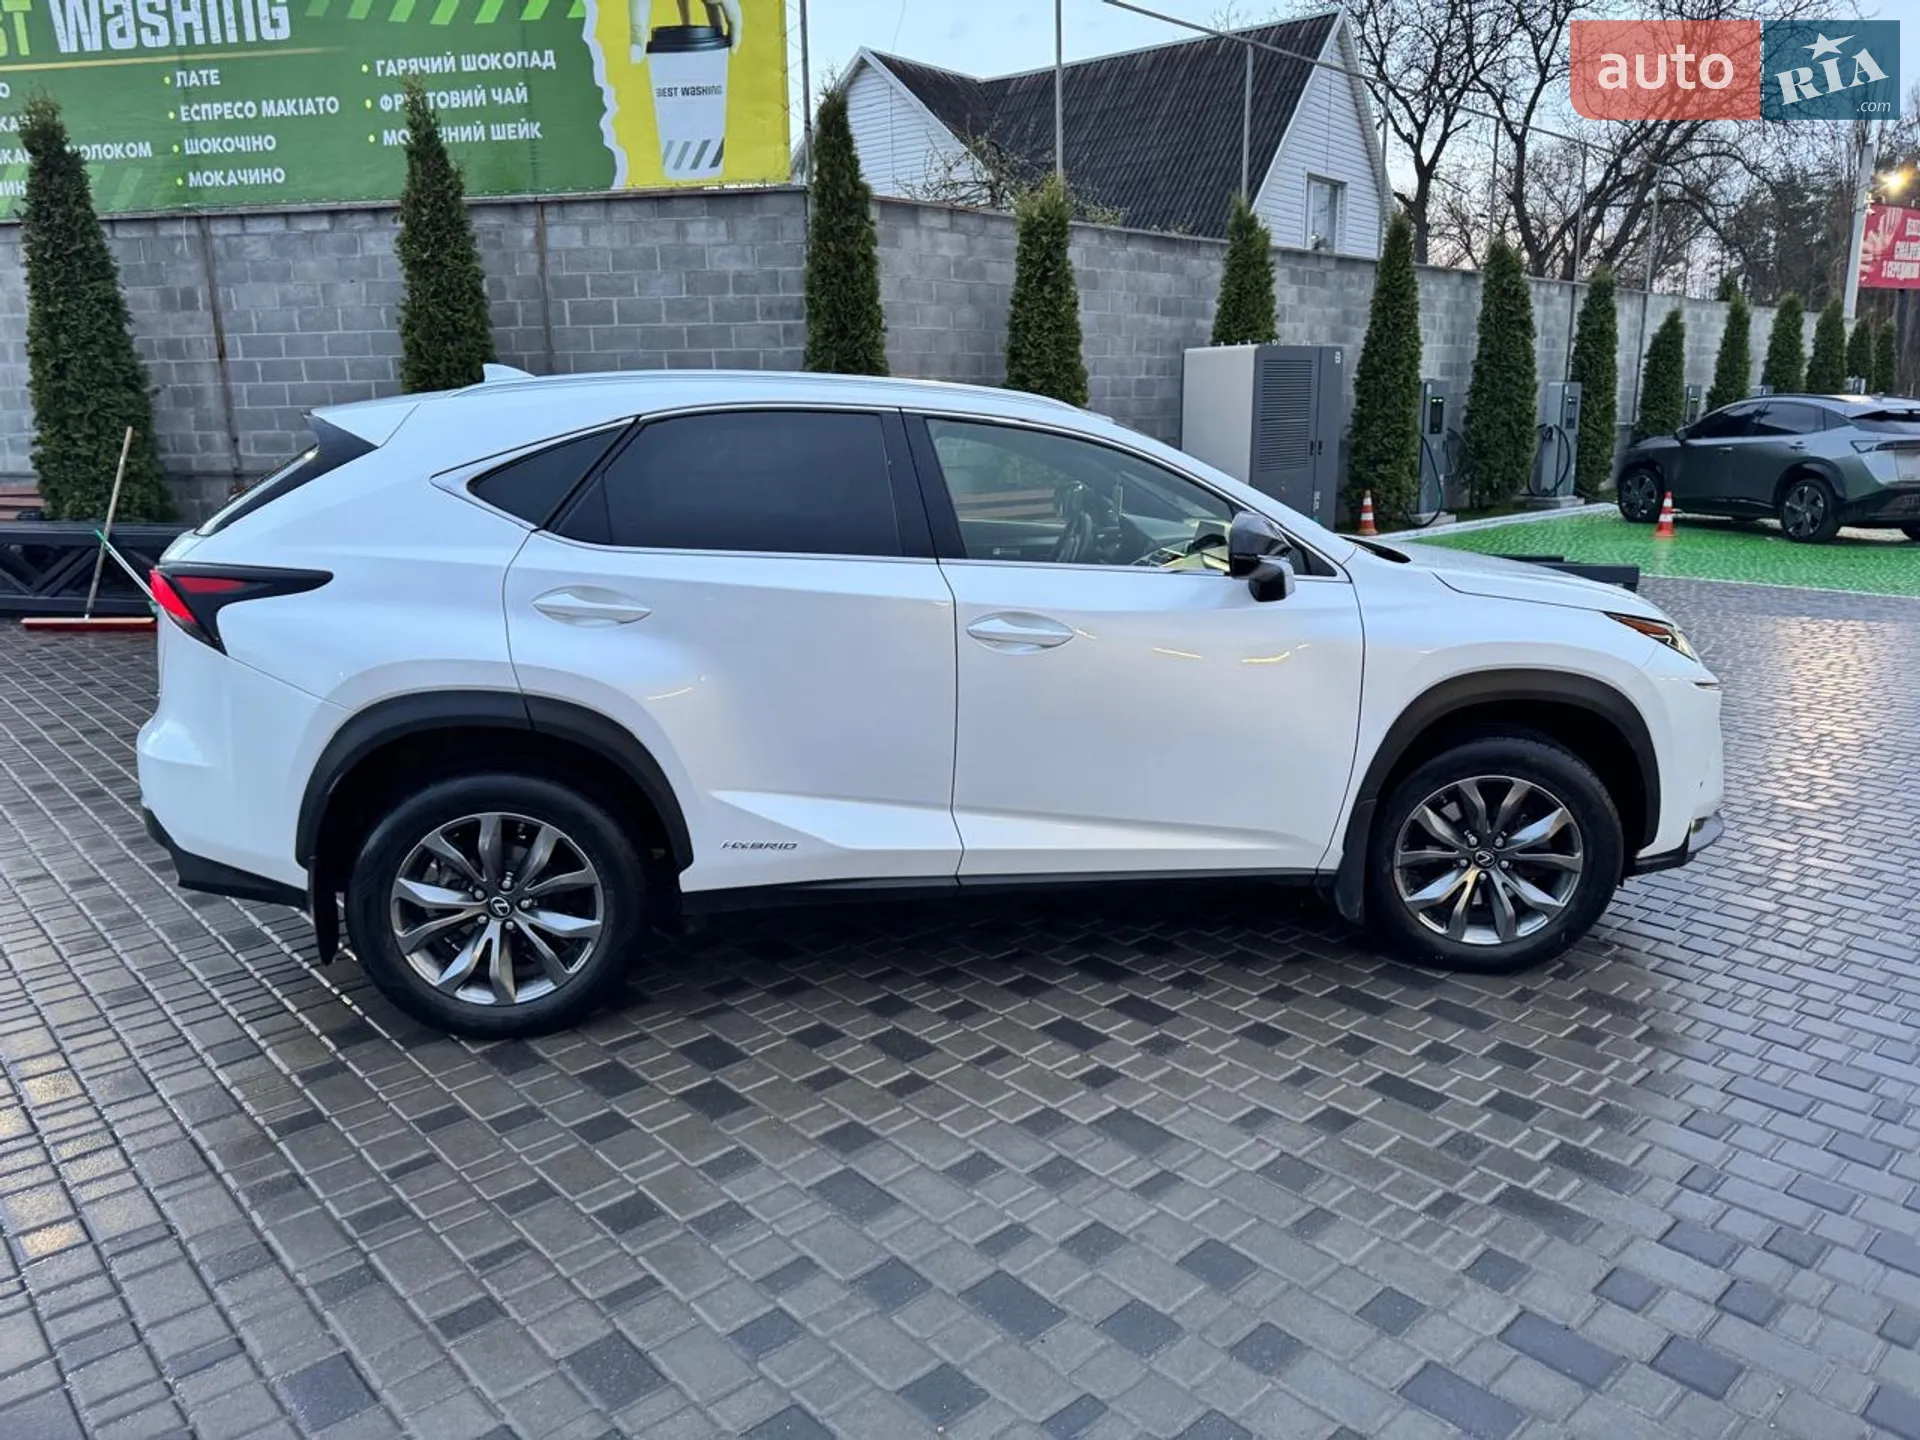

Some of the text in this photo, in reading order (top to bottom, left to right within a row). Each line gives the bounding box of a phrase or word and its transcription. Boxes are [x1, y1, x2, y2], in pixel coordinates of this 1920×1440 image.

[376, 50, 556, 77] ГАРЯЧИЙ ШОКОЛАД
[176, 69, 221, 88] ЛАТЕ
[380, 82, 528, 112] ФРТОВИЙ ЧАЙ
[656, 87, 679, 97] BEST
[180, 96, 339, 122] ЕСПРЕСО МАКІАТО
[383, 118, 543, 146] МОЧНИЙ ШЕЙК
[184, 135, 276, 155] ШОКОЧІНО
[188, 168, 285, 188] МОКАЧИНО
[721, 841, 798, 850] HYBRID
